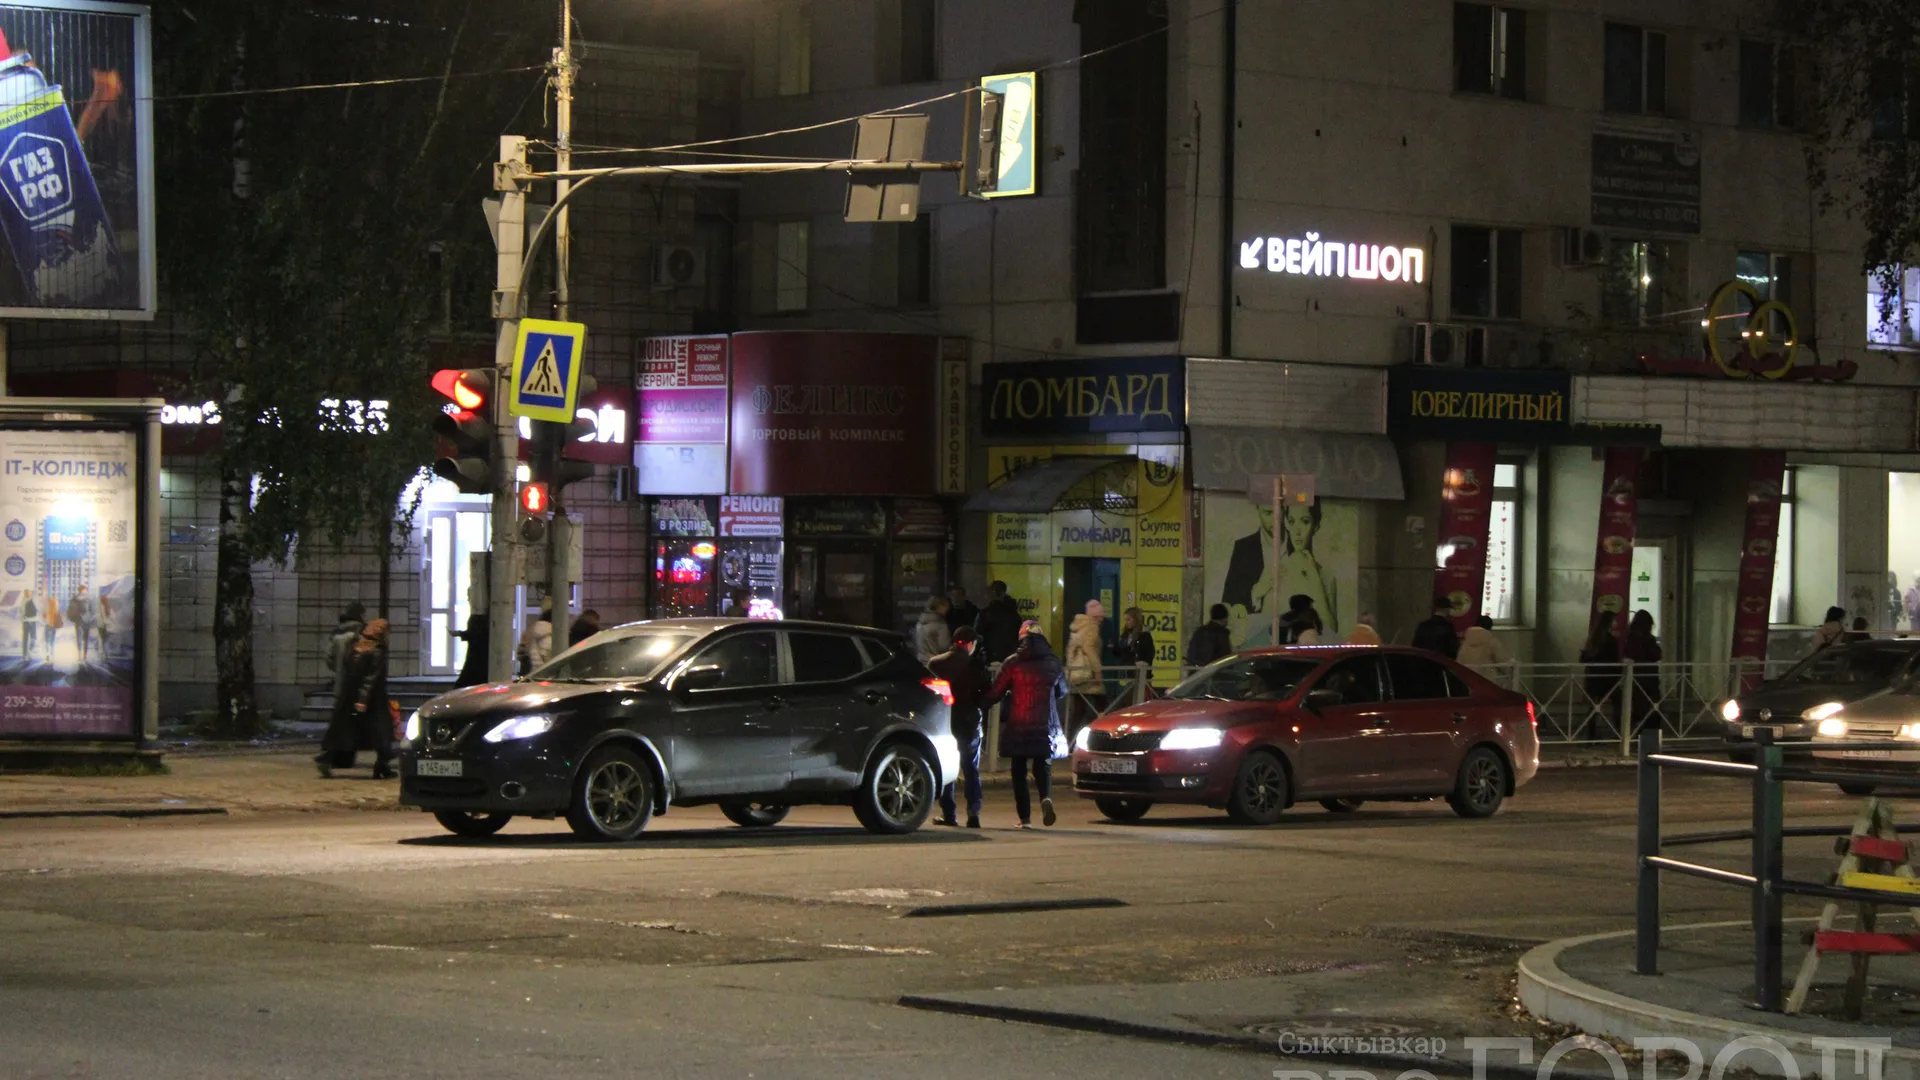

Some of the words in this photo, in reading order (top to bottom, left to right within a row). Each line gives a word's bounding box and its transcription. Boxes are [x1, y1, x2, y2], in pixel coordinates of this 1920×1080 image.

[8, 146, 55, 183] ГАЗ
[20, 173, 63, 208] РФ
[1267, 231, 1424, 284] ВЕЙПШОП
[639, 339, 677, 360] MOBILE
[677, 338, 687, 387] DELUXE
[637, 374, 676, 387] СЕРВИС
[752, 385, 905, 415] ФЕЛИКС
[990, 373, 1173, 424] ЛОМБАРД
[1411, 389, 1563, 422] ЮВЕЛИРНЫЙ
[752, 427, 821, 441] ТОРГОВЫЙ
[829, 428, 905, 442] КОМПЛЕКС
[949, 363, 961, 491] ГРАВИРОВКА
[5, 460, 128, 479] IT-КОЛЛЕДЖ
[721, 496, 781, 512] РЕМОНТ
[669, 520, 707, 531] РОЗЛИВ
[1139, 519, 1181, 536] Скупка
[1059, 526, 1132, 546] ЛОМБАРД
[1140, 537, 1180, 548] золота
[1140, 592, 1179, 604] ЛОМБАРД
[1156, 644, 1178, 661] :18
